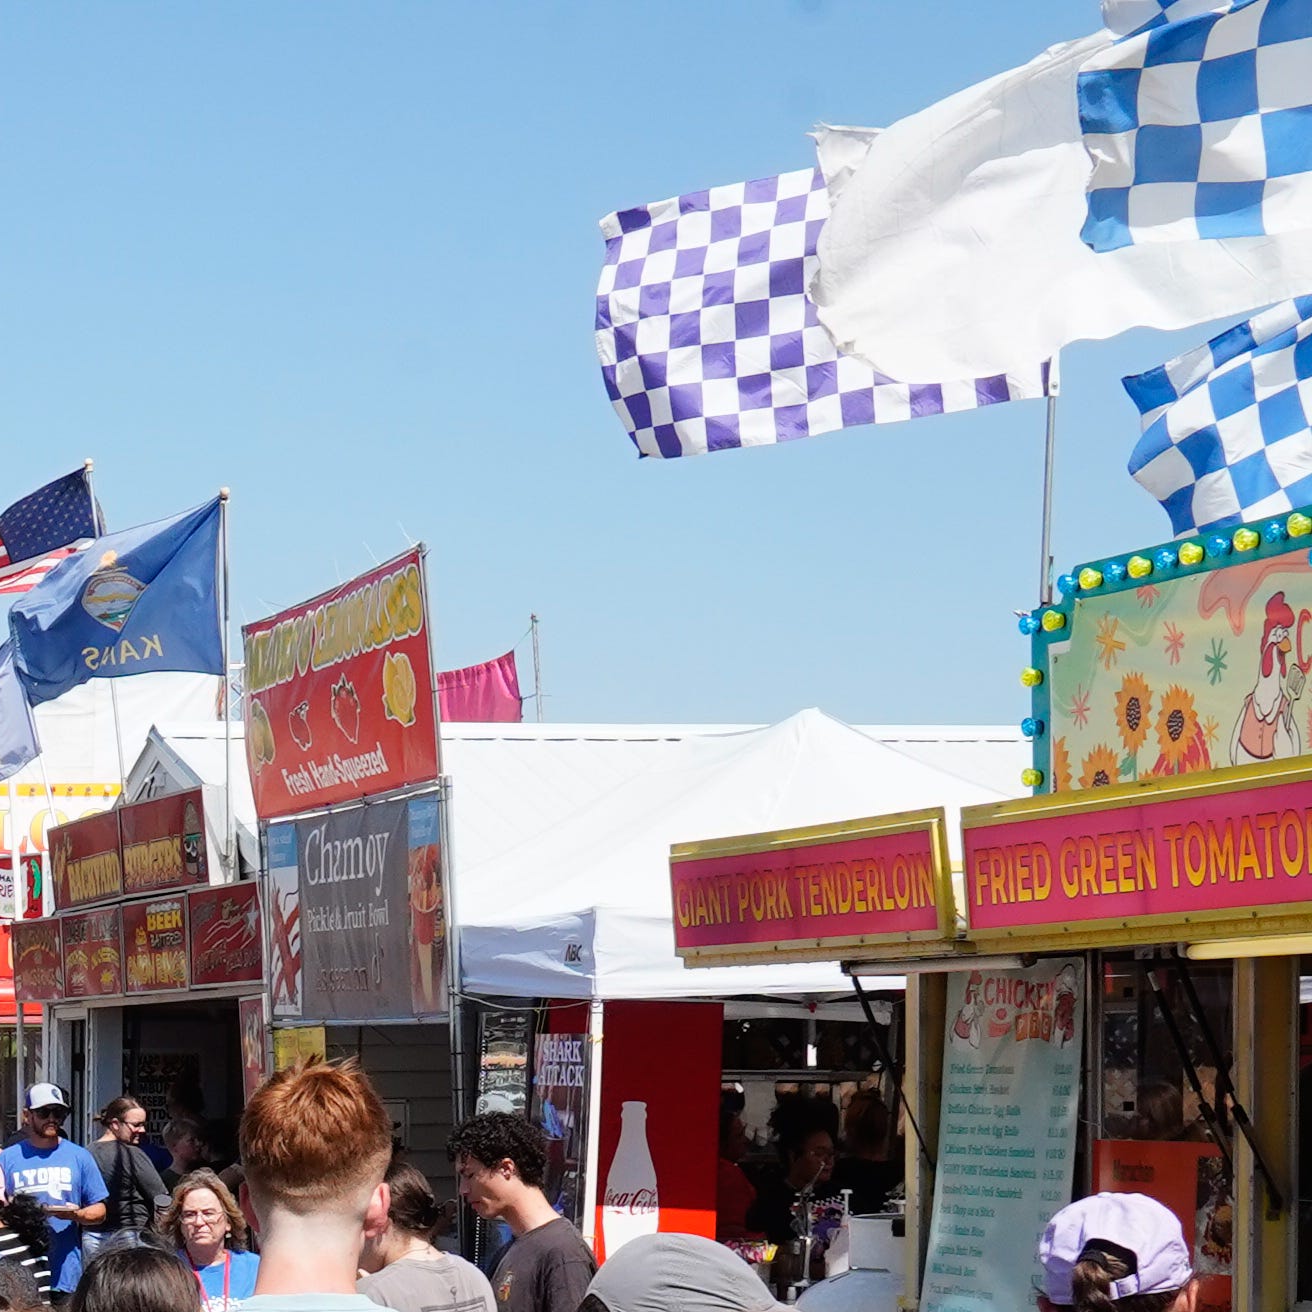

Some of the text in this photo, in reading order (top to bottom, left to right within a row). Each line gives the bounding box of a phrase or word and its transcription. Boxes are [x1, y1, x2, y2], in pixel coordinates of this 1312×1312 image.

[281, 763, 314, 796] Fresh
[305, 823, 390, 896] Chamoy
[976, 842, 1052, 906] FRIED
[1060, 833, 1156, 898] GREEN
[676, 852, 936, 929] GIANT PORK TENDERLOIN
[146, 903, 183, 931] BEER
[984, 977, 1056, 1010] CHICKEN
[542, 1040, 581, 1063] SHARK
[538, 1064, 585, 1087] ATTACK
[13, 1167, 72, 1188] LYONS
